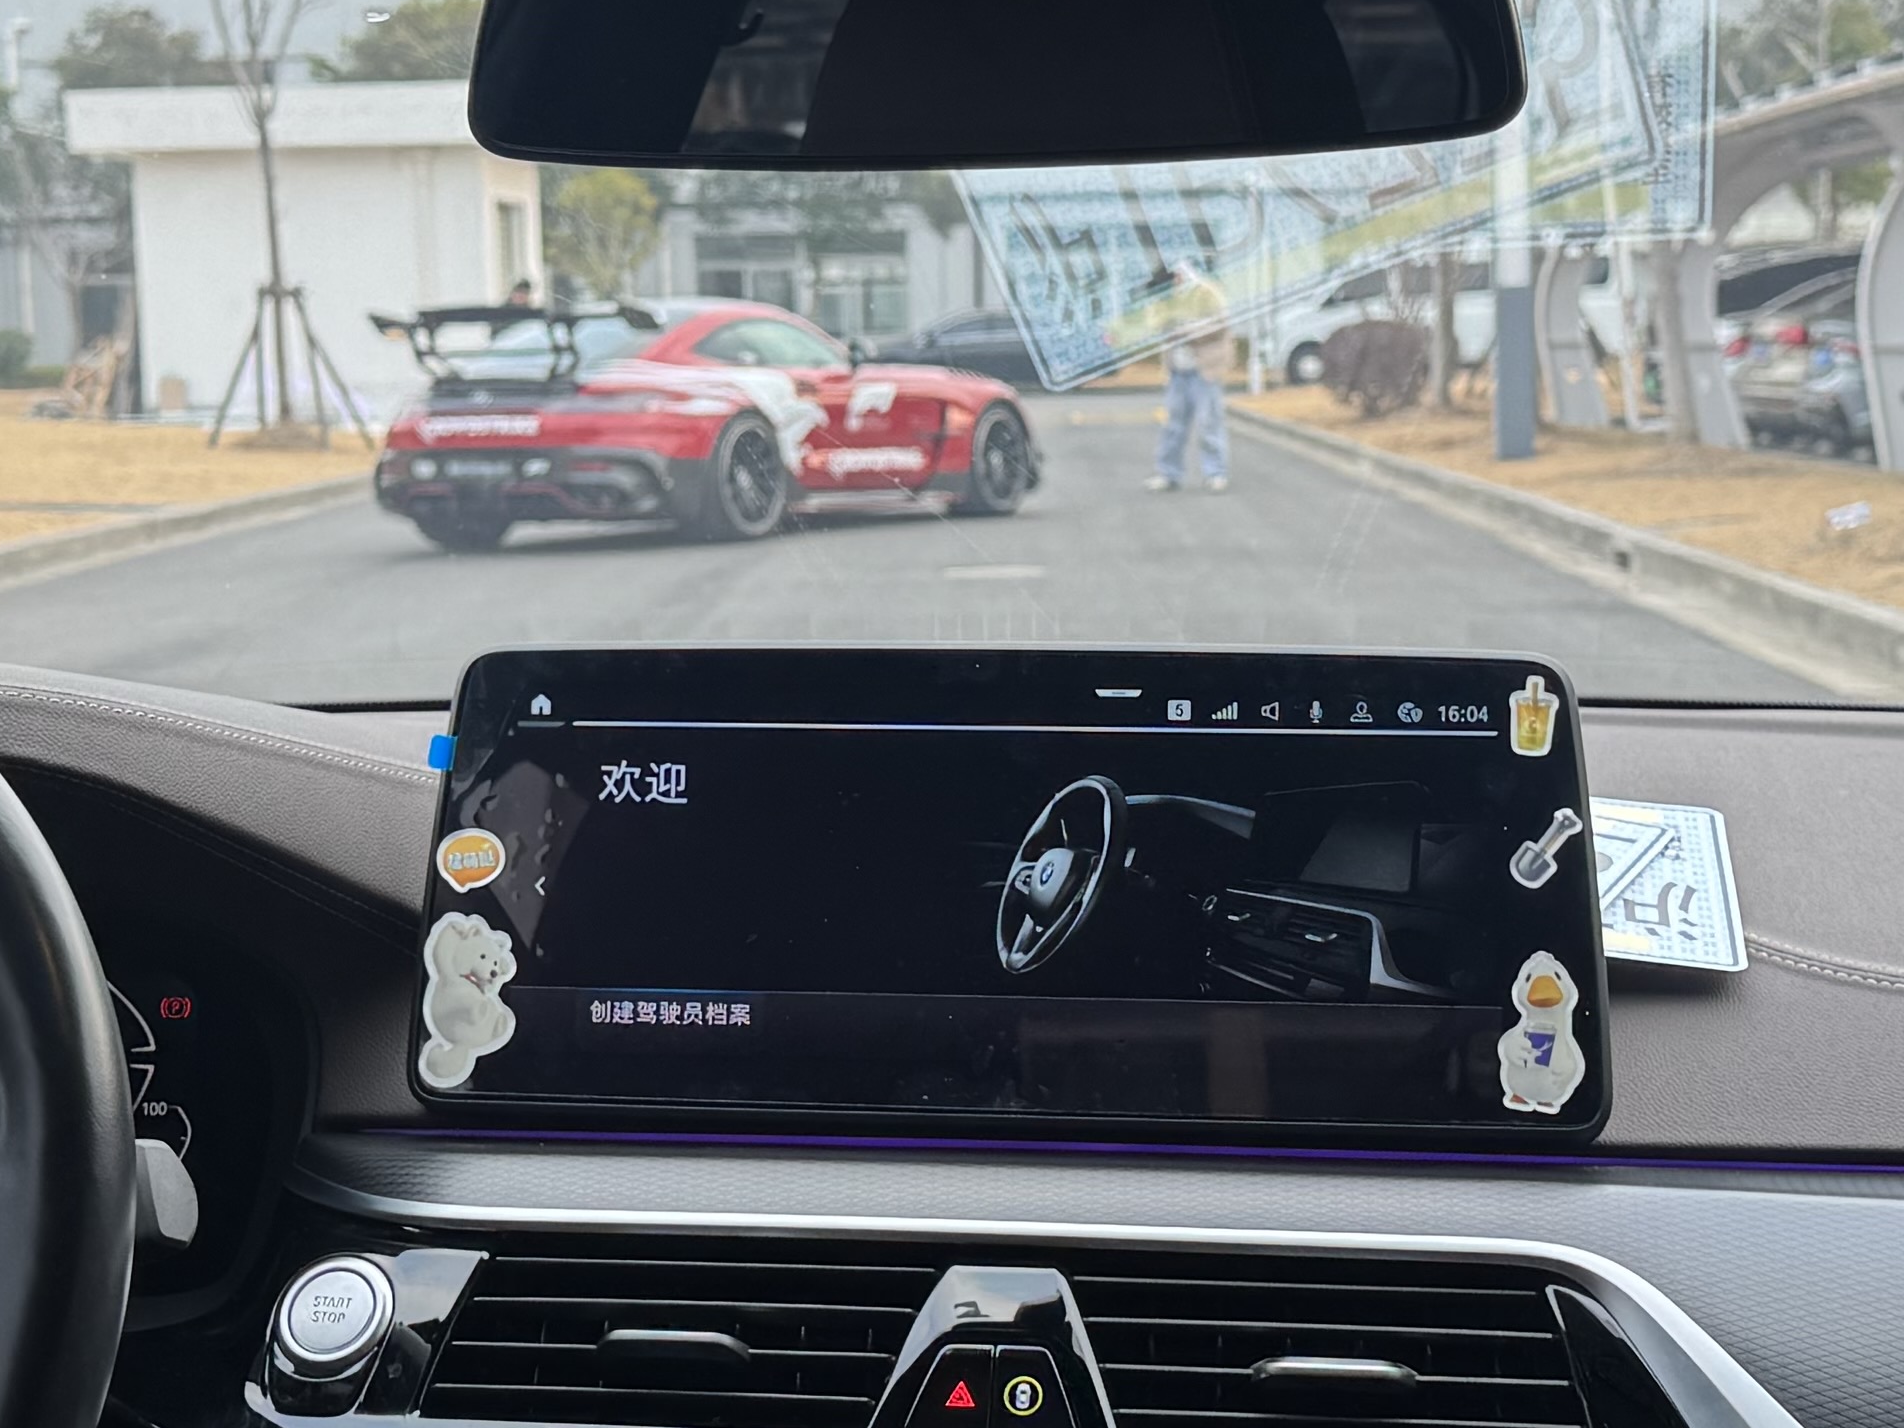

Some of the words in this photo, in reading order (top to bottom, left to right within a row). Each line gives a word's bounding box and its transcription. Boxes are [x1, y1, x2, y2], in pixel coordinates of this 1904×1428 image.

[1435, 704, 1491, 725] 16:04
[597, 759, 689, 805] 欢迎
[589, 999, 752, 1028] 创建驾驶员档案
[141, 1101, 168, 1117] 100
[312, 1295, 353, 1310] START
[311, 1310, 346, 1324] STOP
